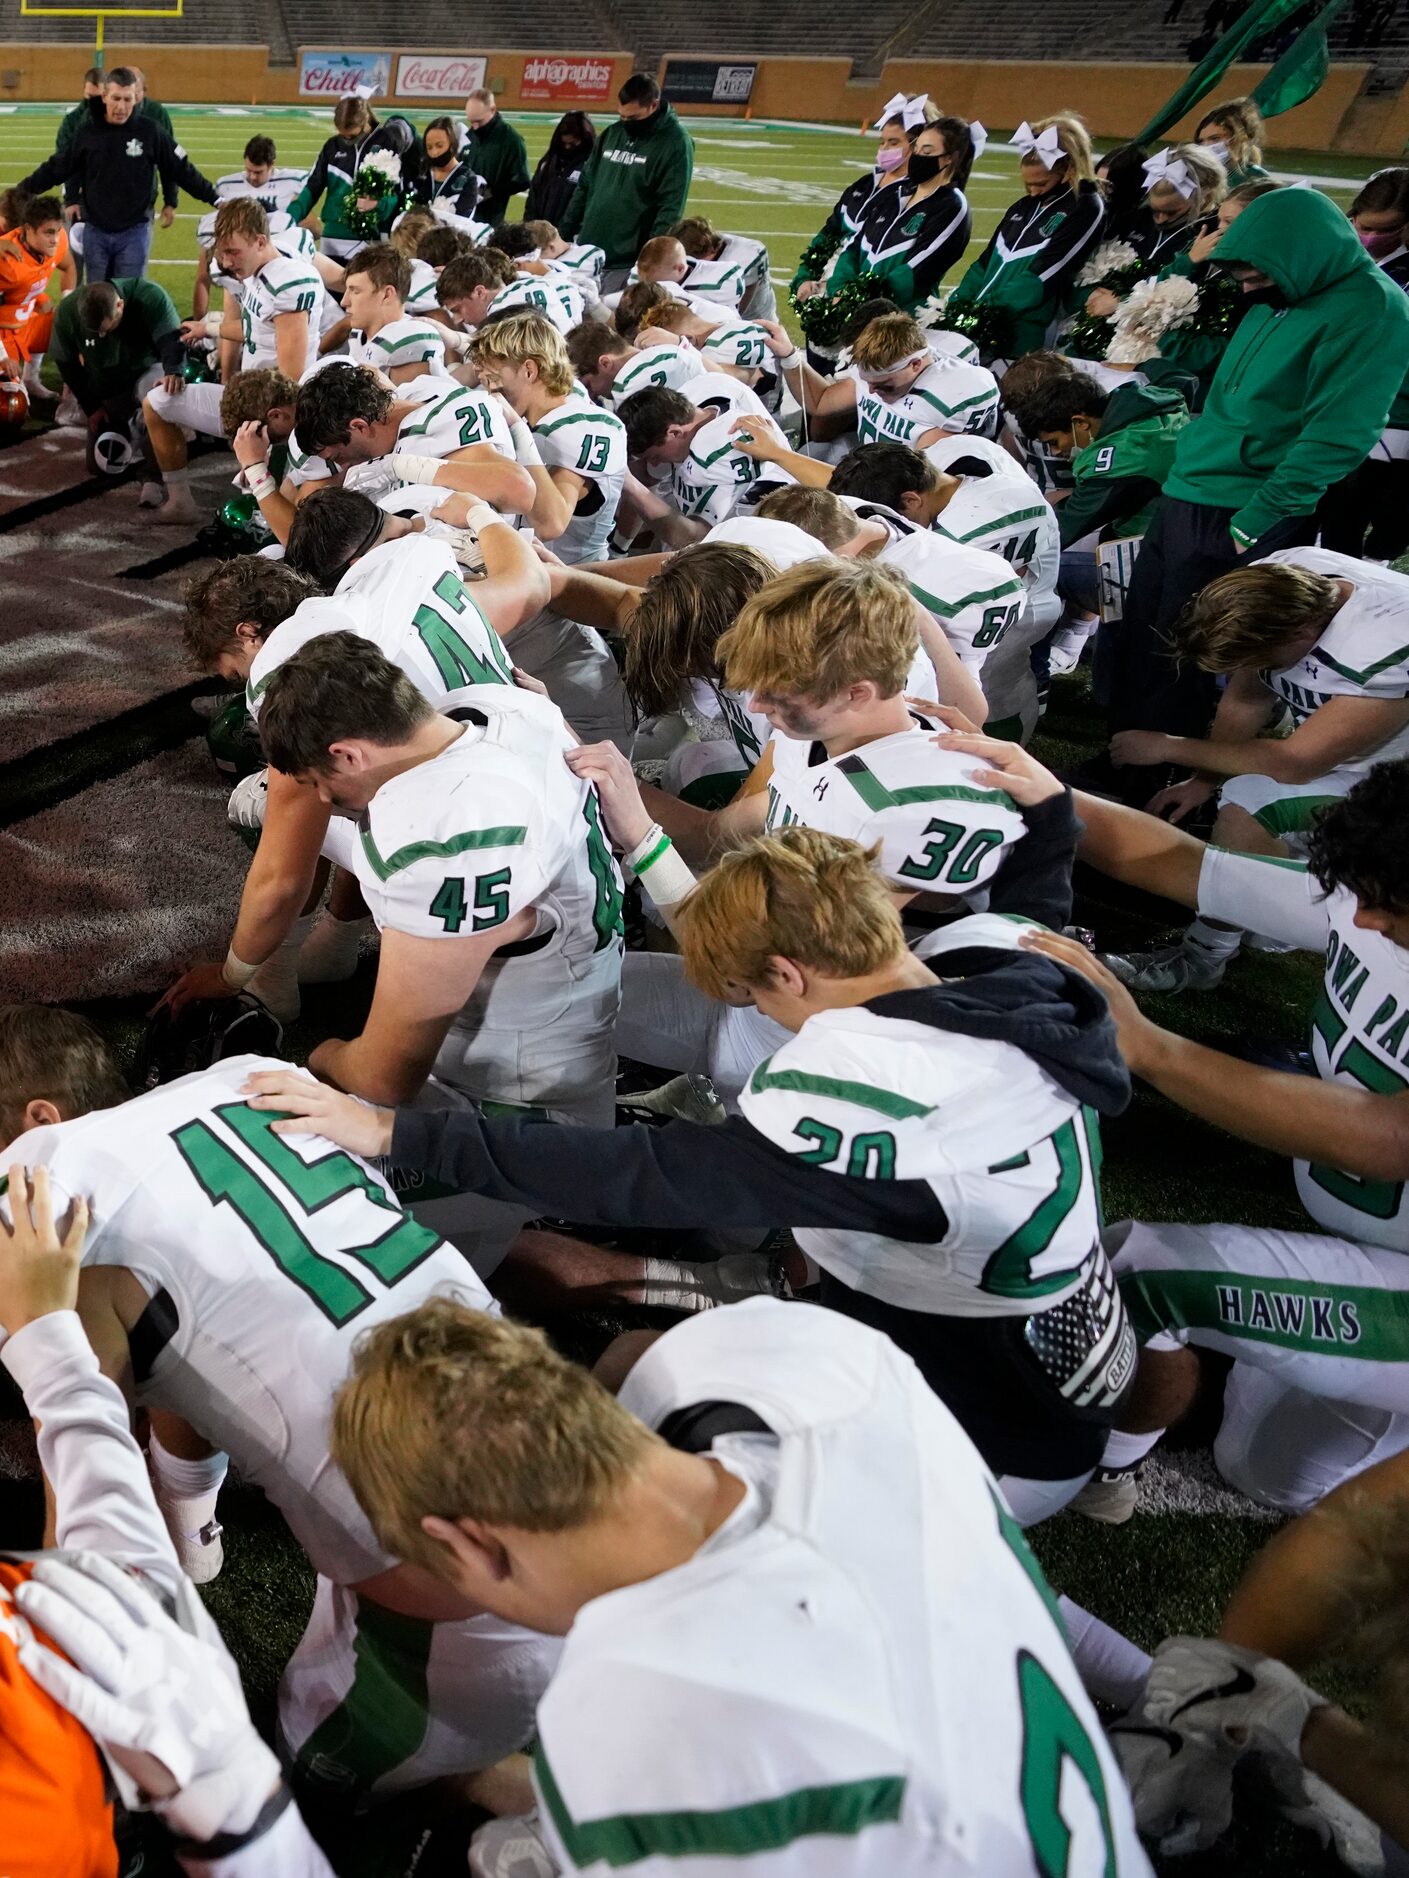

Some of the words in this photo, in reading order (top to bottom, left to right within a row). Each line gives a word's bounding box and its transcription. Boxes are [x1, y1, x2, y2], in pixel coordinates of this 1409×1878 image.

[305, 68, 365, 91] Chill
[524, 58, 611, 85] alphagraphics
[735, 340, 764, 365] 27
[455, 402, 493, 445] 21
[858, 395, 883, 425] IOWA
[885, 412, 916, 441] PARK
[576, 434, 610, 473] 13
[1094, 446, 1116, 473] 9
[1003, 527, 1040, 567] 14
[897, 817, 1004, 884] 30
[430, 866, 512, 933] 45
[1327, 929, 1370, 1015] OWA
[792, 1116, 897, 1180] 20
[170, 1098, 445, 1329] 15
[1216, 1283, 1361, 1342] HAWKS
